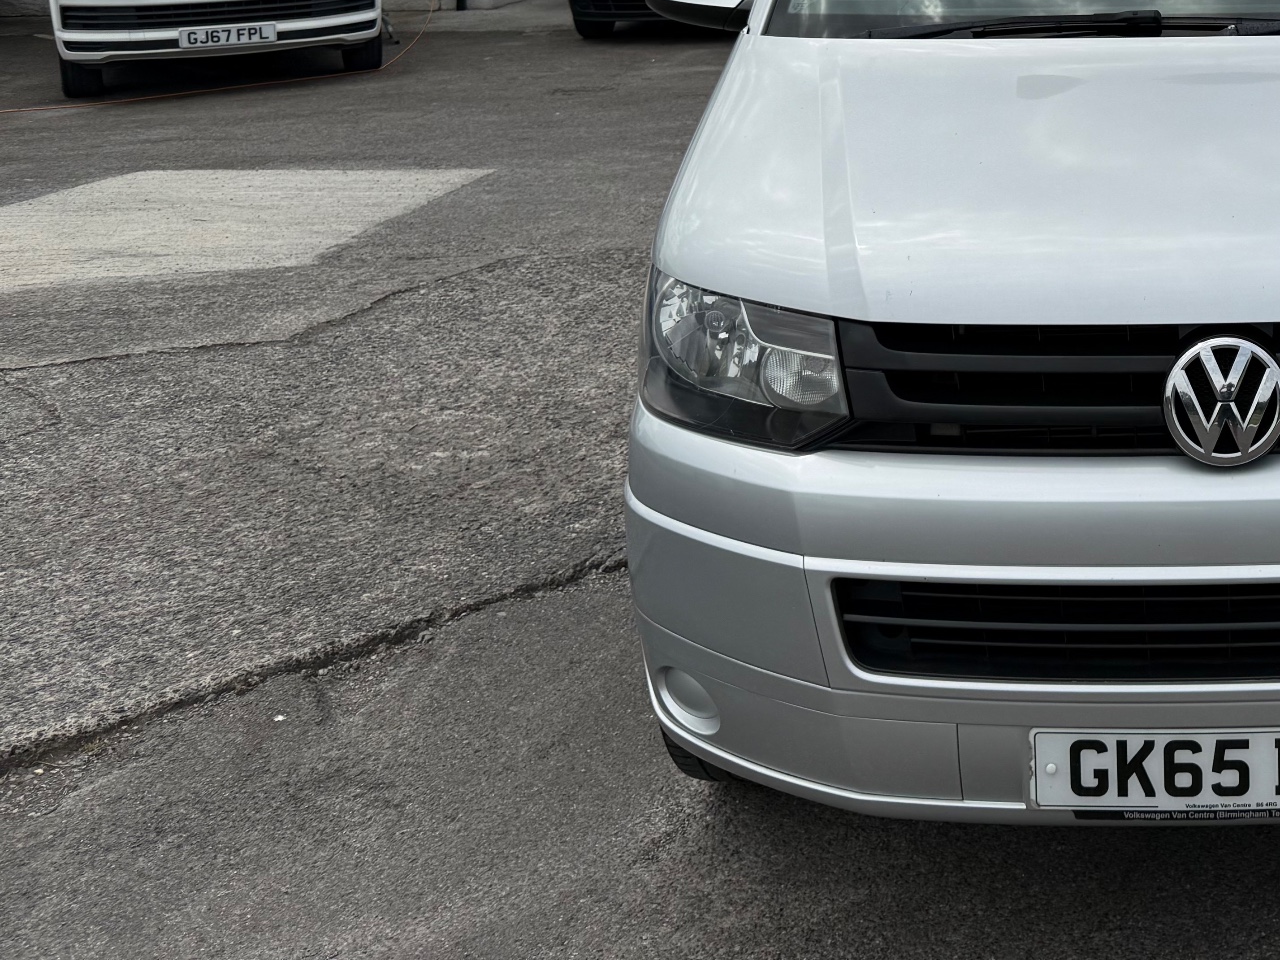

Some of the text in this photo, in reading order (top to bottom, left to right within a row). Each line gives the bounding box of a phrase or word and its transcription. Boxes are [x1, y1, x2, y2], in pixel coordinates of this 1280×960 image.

[187, 27, 269, 45] GJ67 FPL
[1069, 737, 1251, 798] GK65
[1123, 811, 1168, 821] Volkswagen
[1172, 811, 1187, 819] Van
[1188, 811, 1214, 819] Centre
[1216, 810, 1270, 820] (Birmingham)
